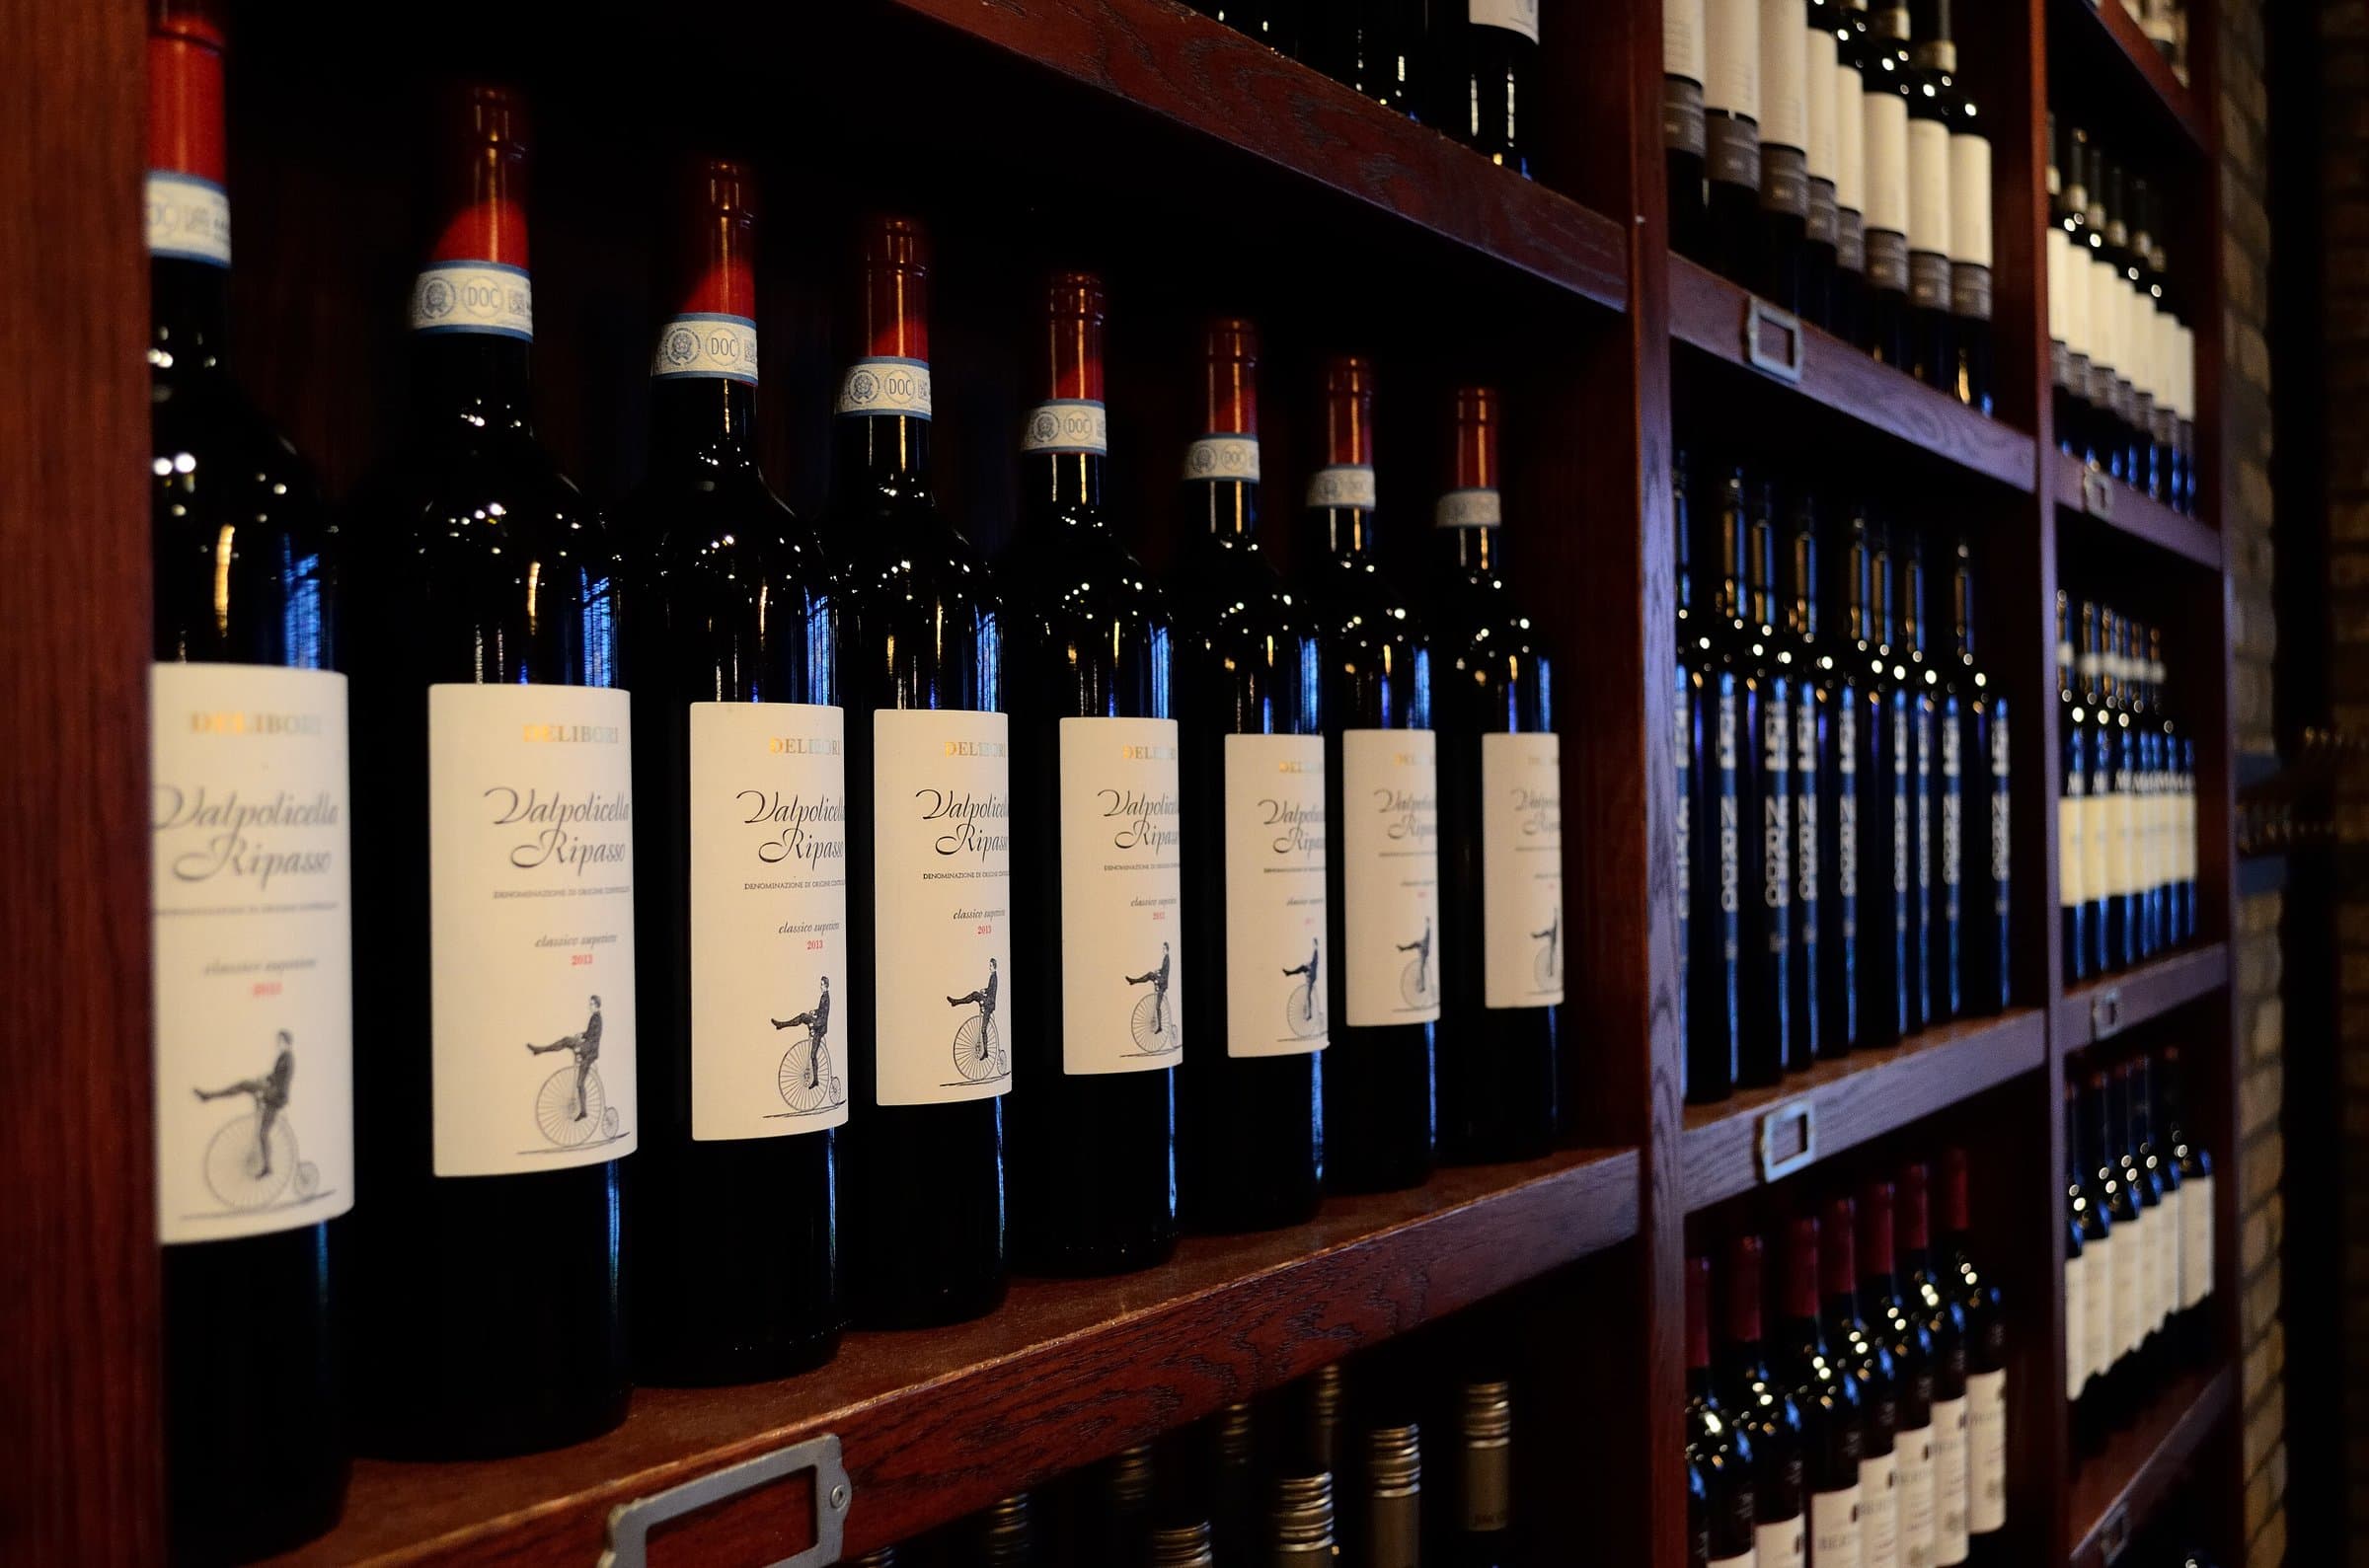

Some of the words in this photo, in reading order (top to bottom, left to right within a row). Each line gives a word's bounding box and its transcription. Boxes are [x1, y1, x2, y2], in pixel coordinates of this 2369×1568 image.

[467, 286, 498, 309] DOC
[711, 337, 736, 357] DOC
[888, 379, 912, 396] DOC
[483, 786, 632, 827] Valpolicella
[509, 828, 626, 877] Ripasso
[743, 882, 803, 891] DENOMINAZIONE
[953, 908, 983, 920] classico
[778, 921, 812, 934] classico
[806, 939, 823, 950] 2013
